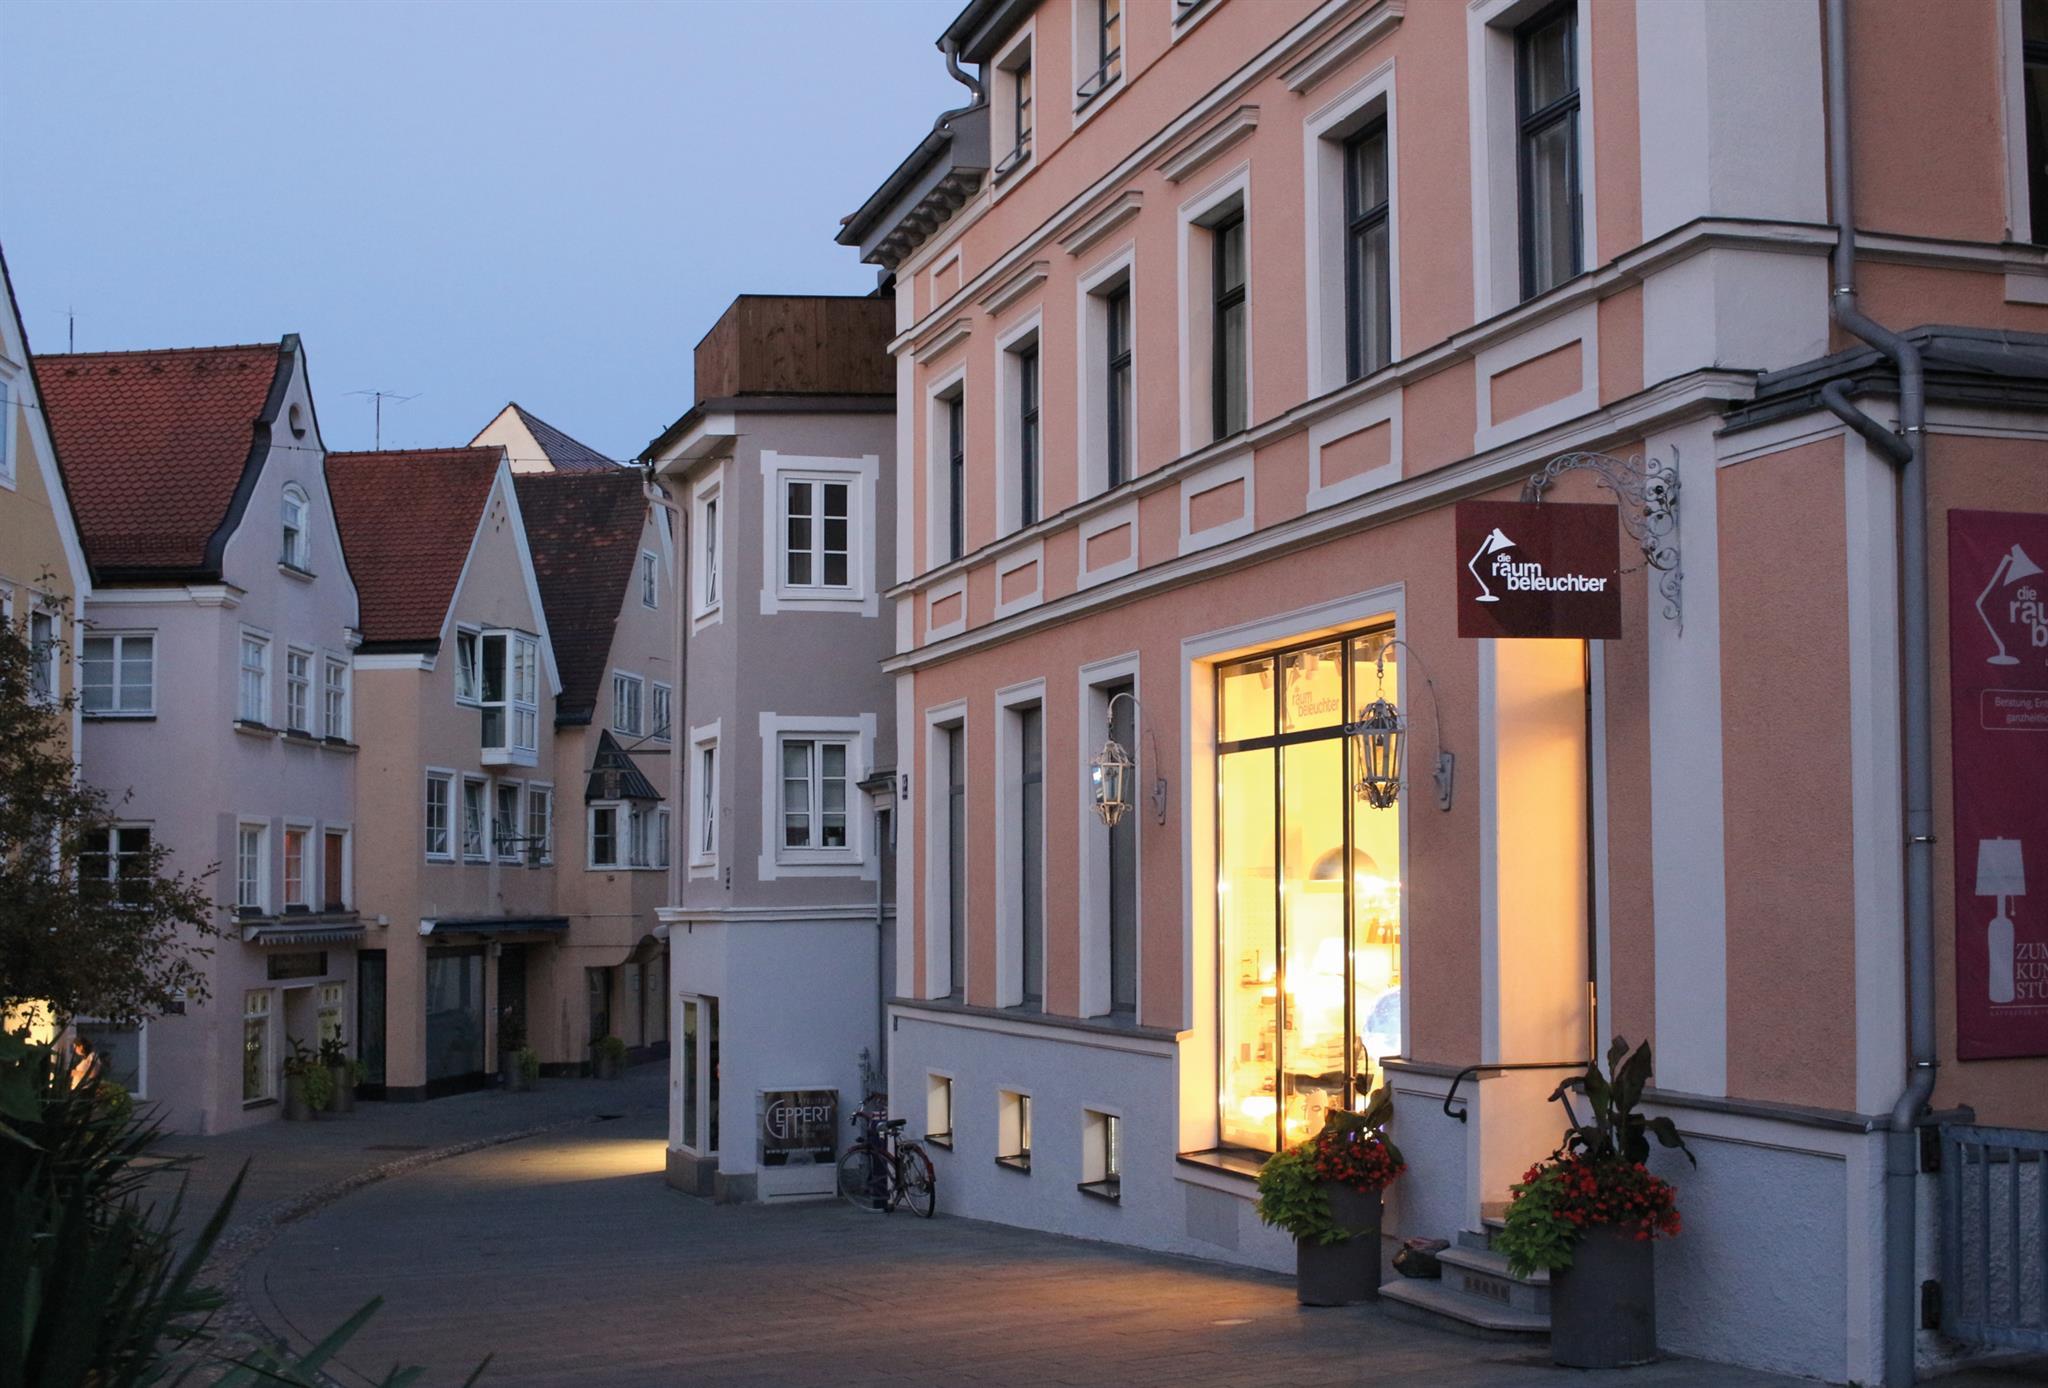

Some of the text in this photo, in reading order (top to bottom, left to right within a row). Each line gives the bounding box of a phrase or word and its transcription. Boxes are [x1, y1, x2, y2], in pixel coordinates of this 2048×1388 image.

[1497, 553, 1511, 562] die
[1492, 562, 1541, 577] raum
[1507, 573, 1607, 592] beleuchter
[2017, 586, 2037, 600] die
[765, 1099, 831, 1139] GEPPERT
